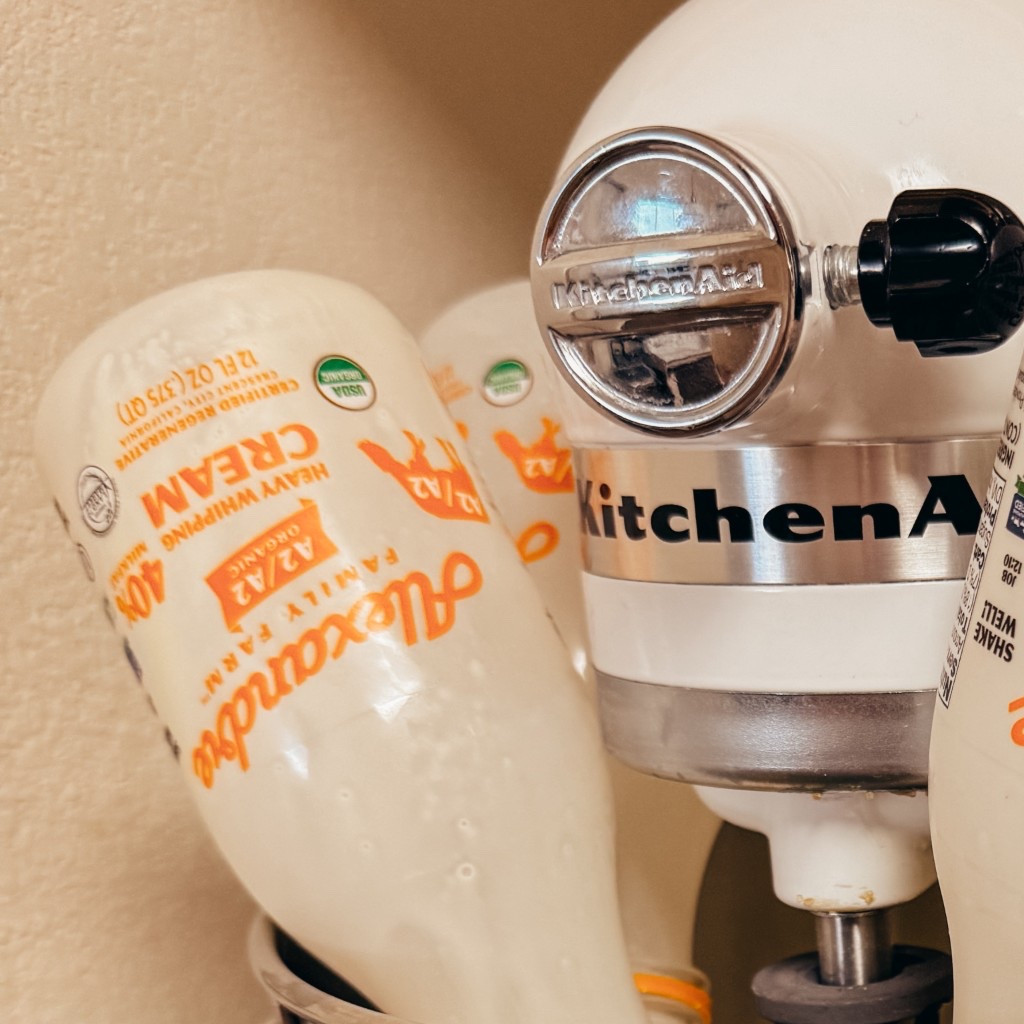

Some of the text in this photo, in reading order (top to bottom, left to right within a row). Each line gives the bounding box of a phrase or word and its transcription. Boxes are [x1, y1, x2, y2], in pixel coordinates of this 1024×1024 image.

[553, 263, 766, 309] KitchenAid
[186, 364, 213, 390] OZ
[214, 356, 238, 376] FL
[236, 350, 256, 368] 12
[118, 396, 146, 426] QT)
[330, 384, 367, 399] USDA
[115, 380, 298, 470] CERTIFIED REGENERATIVE
[140, 423, 318, 528] CREAM
[261, 464, 328, 498] HEAVY
[160, 488, 259, 550] WHIPPING
[578, 474, 984, 543] KitchenA
[226, 522, 302, 579] ORGANIC
[1004, 554, 1022, 574] 12:10
[226, 533, 319, 609] A2/A2
[288, 548, 398, 620] FAMILY
[1002, 570, 1016, 587] JOB
[982, 600, 1016, 638] WELL!
[974, 622, 1014, 662] SHAKE
[191, 550, 483, 789] Alexandre
